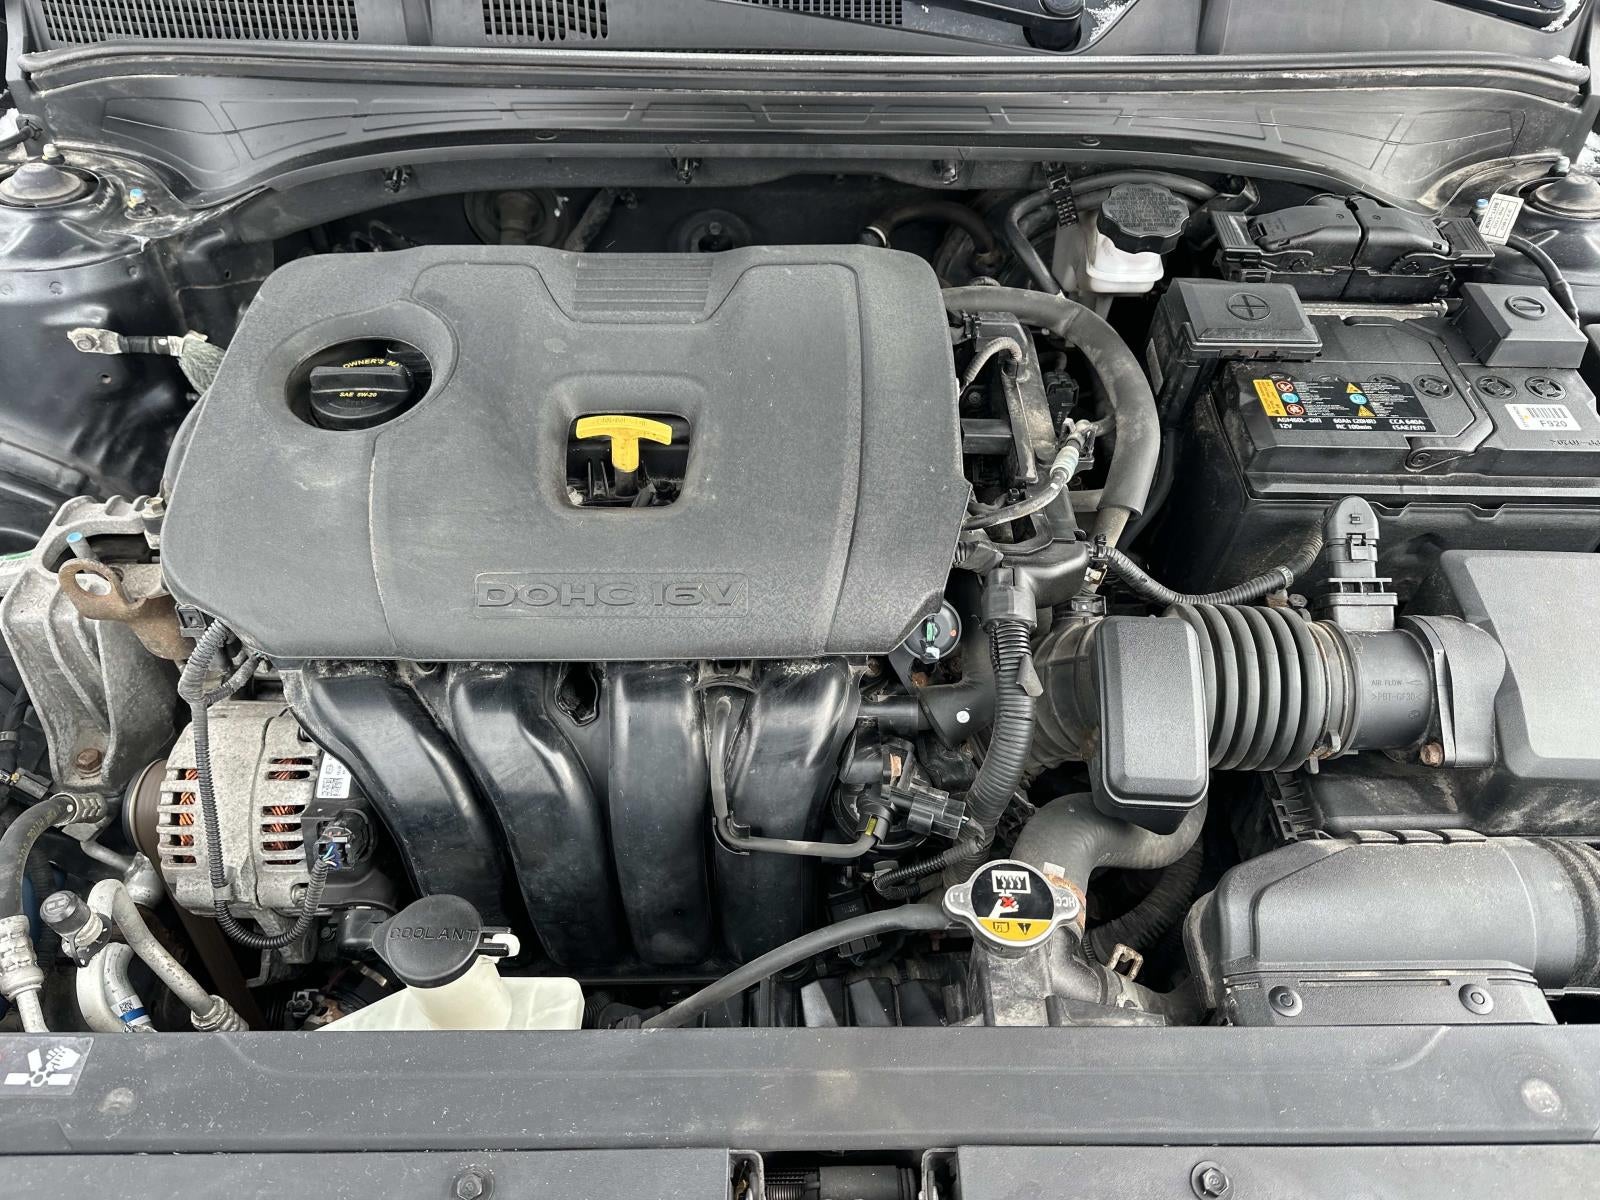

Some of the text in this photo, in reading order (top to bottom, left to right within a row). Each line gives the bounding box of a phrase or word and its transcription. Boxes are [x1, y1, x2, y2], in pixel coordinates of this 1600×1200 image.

[342, 358, 385, 369] OWNER'S
[478, 582, 745, 607] DOHC 16V
[1055, 896, 1076, 908] HCC
[389, 927, 477, 942] COOLANT
